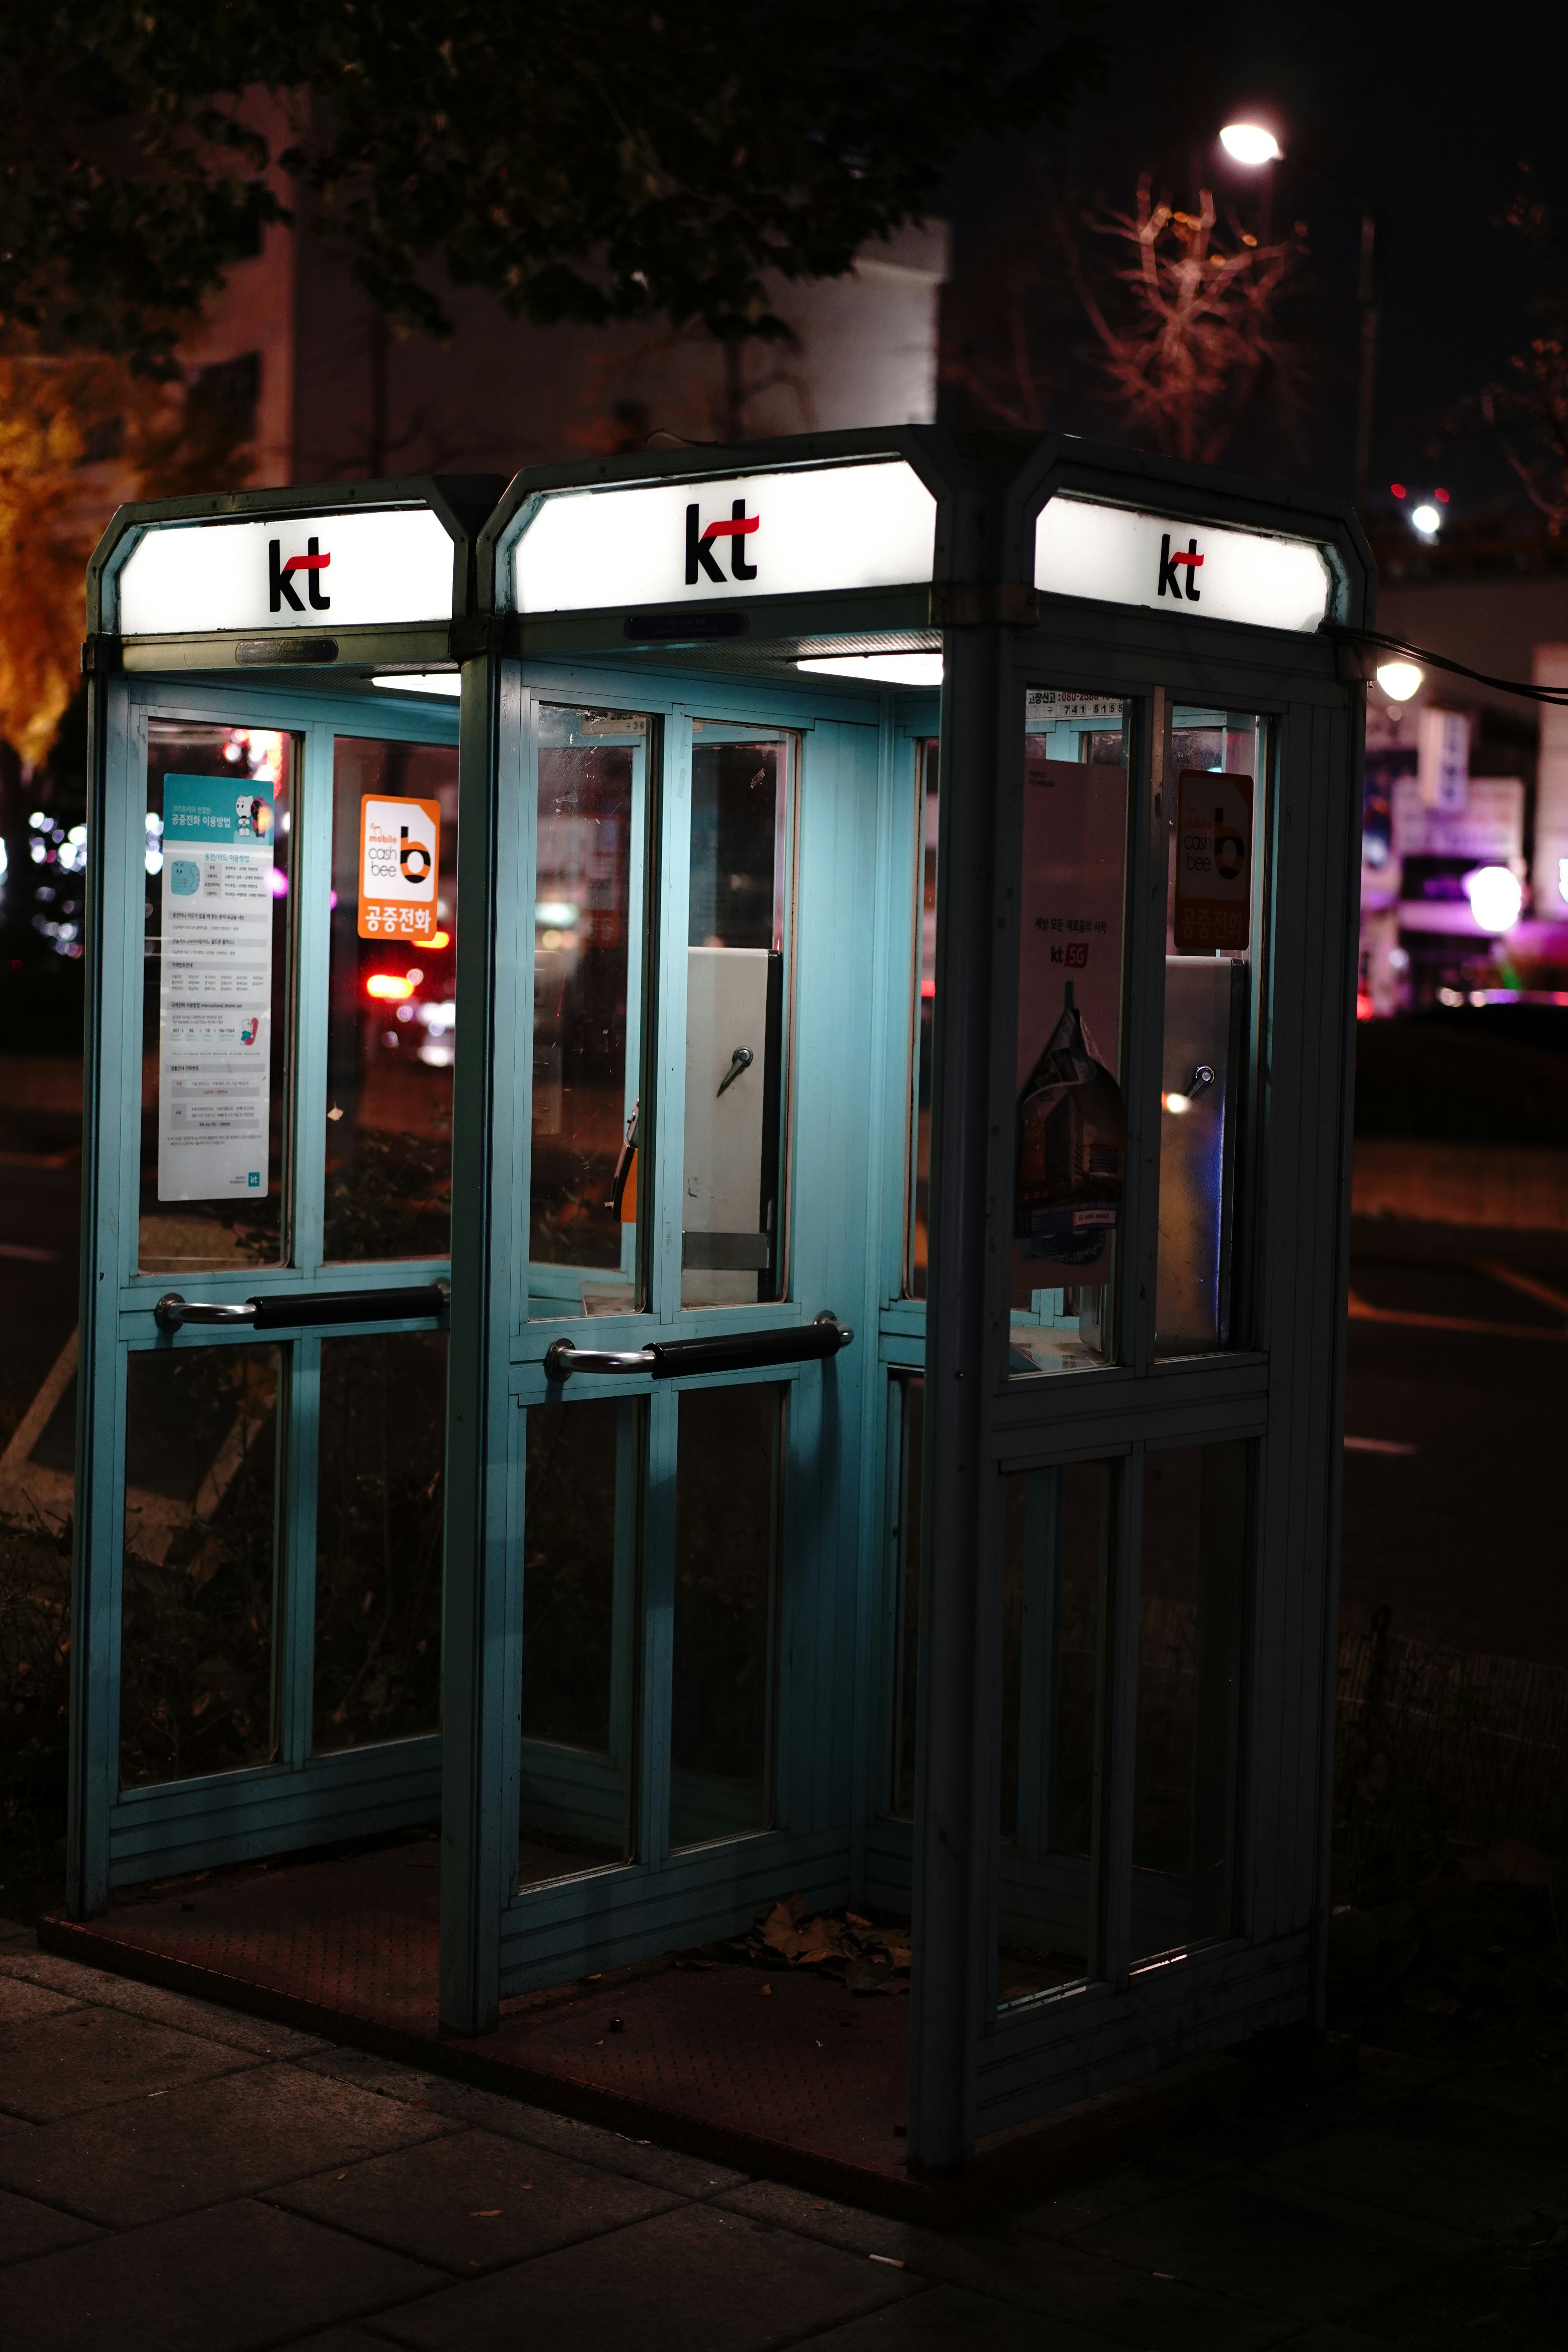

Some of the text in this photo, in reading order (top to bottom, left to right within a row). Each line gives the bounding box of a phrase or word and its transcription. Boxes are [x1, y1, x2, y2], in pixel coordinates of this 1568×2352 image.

[686, 499, 759, 585] kt
[269, 537, 330, 612] kt
[1158, 534, 1204, 601] kt
[1028, 692, 1056, 704] 고장신고
[172, 814, 231, 828] 공중전화 이용방법
[1185, 819, 1212, 830] mobile
[369, 835, 397, 844] mobile
[1184, 833, 1212, 851] cash
[229, 854, 250, 862] 이용방법
[369, 846, 397, 861] cash
[1187, 852, 1211, 871] bee
[371, 862, 397, 877] bee
[365, 906, 431, 934] 공중전화
[1051, 918, 1063, 931] 모든
[1094, 921, 1107, 934] 시작
[1181, 908, 1244, 940] 공중전화
[1051, 946, 1084, 964] kt 5G
